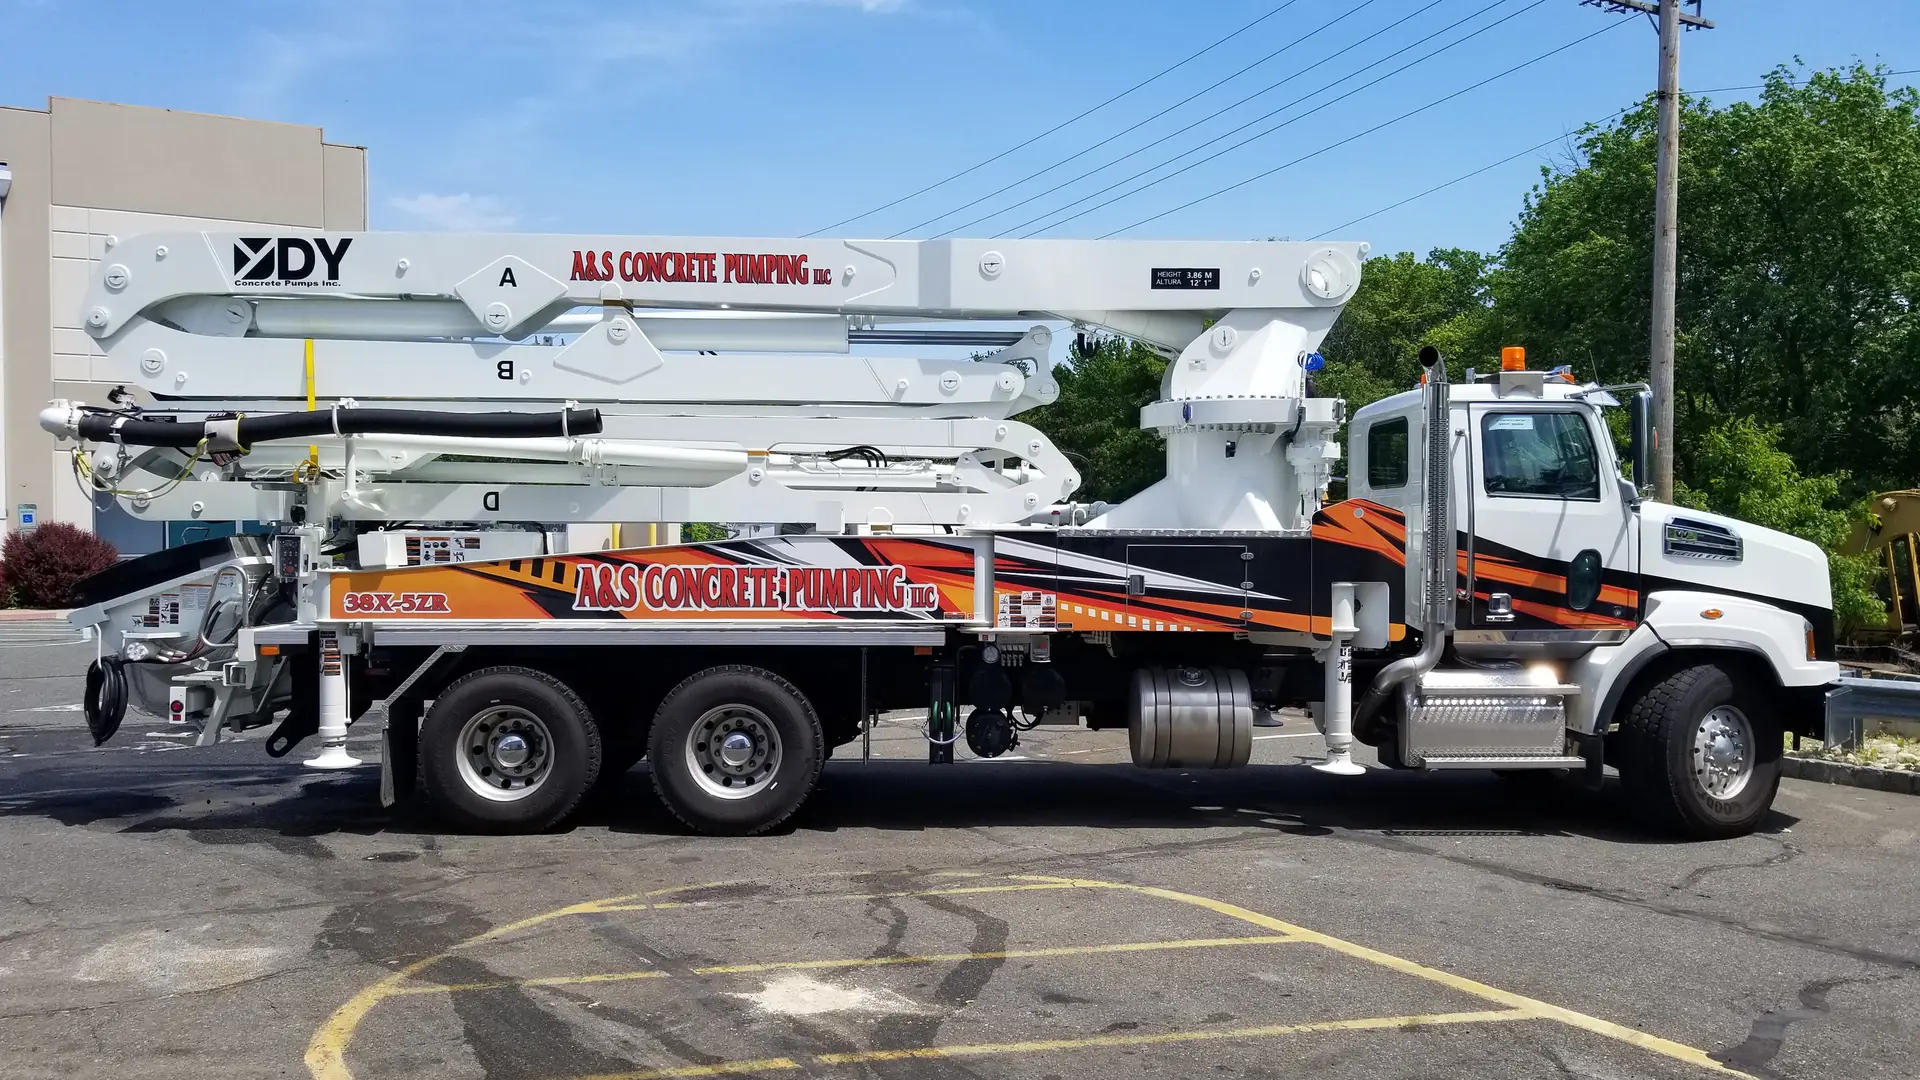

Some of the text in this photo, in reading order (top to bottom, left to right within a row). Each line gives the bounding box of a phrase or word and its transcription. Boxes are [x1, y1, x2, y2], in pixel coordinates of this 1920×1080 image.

[278, 238, 353, 280] DY
[570, 251, 832, 285] A&S CONCRETE PUMPING LLC
[499, 267, 517, 287] A
[1187, 271, 1203, 279] 3.86
[1204, 271, 1213, 279] M
[497, 360, 514, 380] B
[483, 491, 500, 511] D
[574, 565, 937, 611] A&S CONCRETE PUMPING LLC
[344, 592, 451, 613] 38X-5ZR
